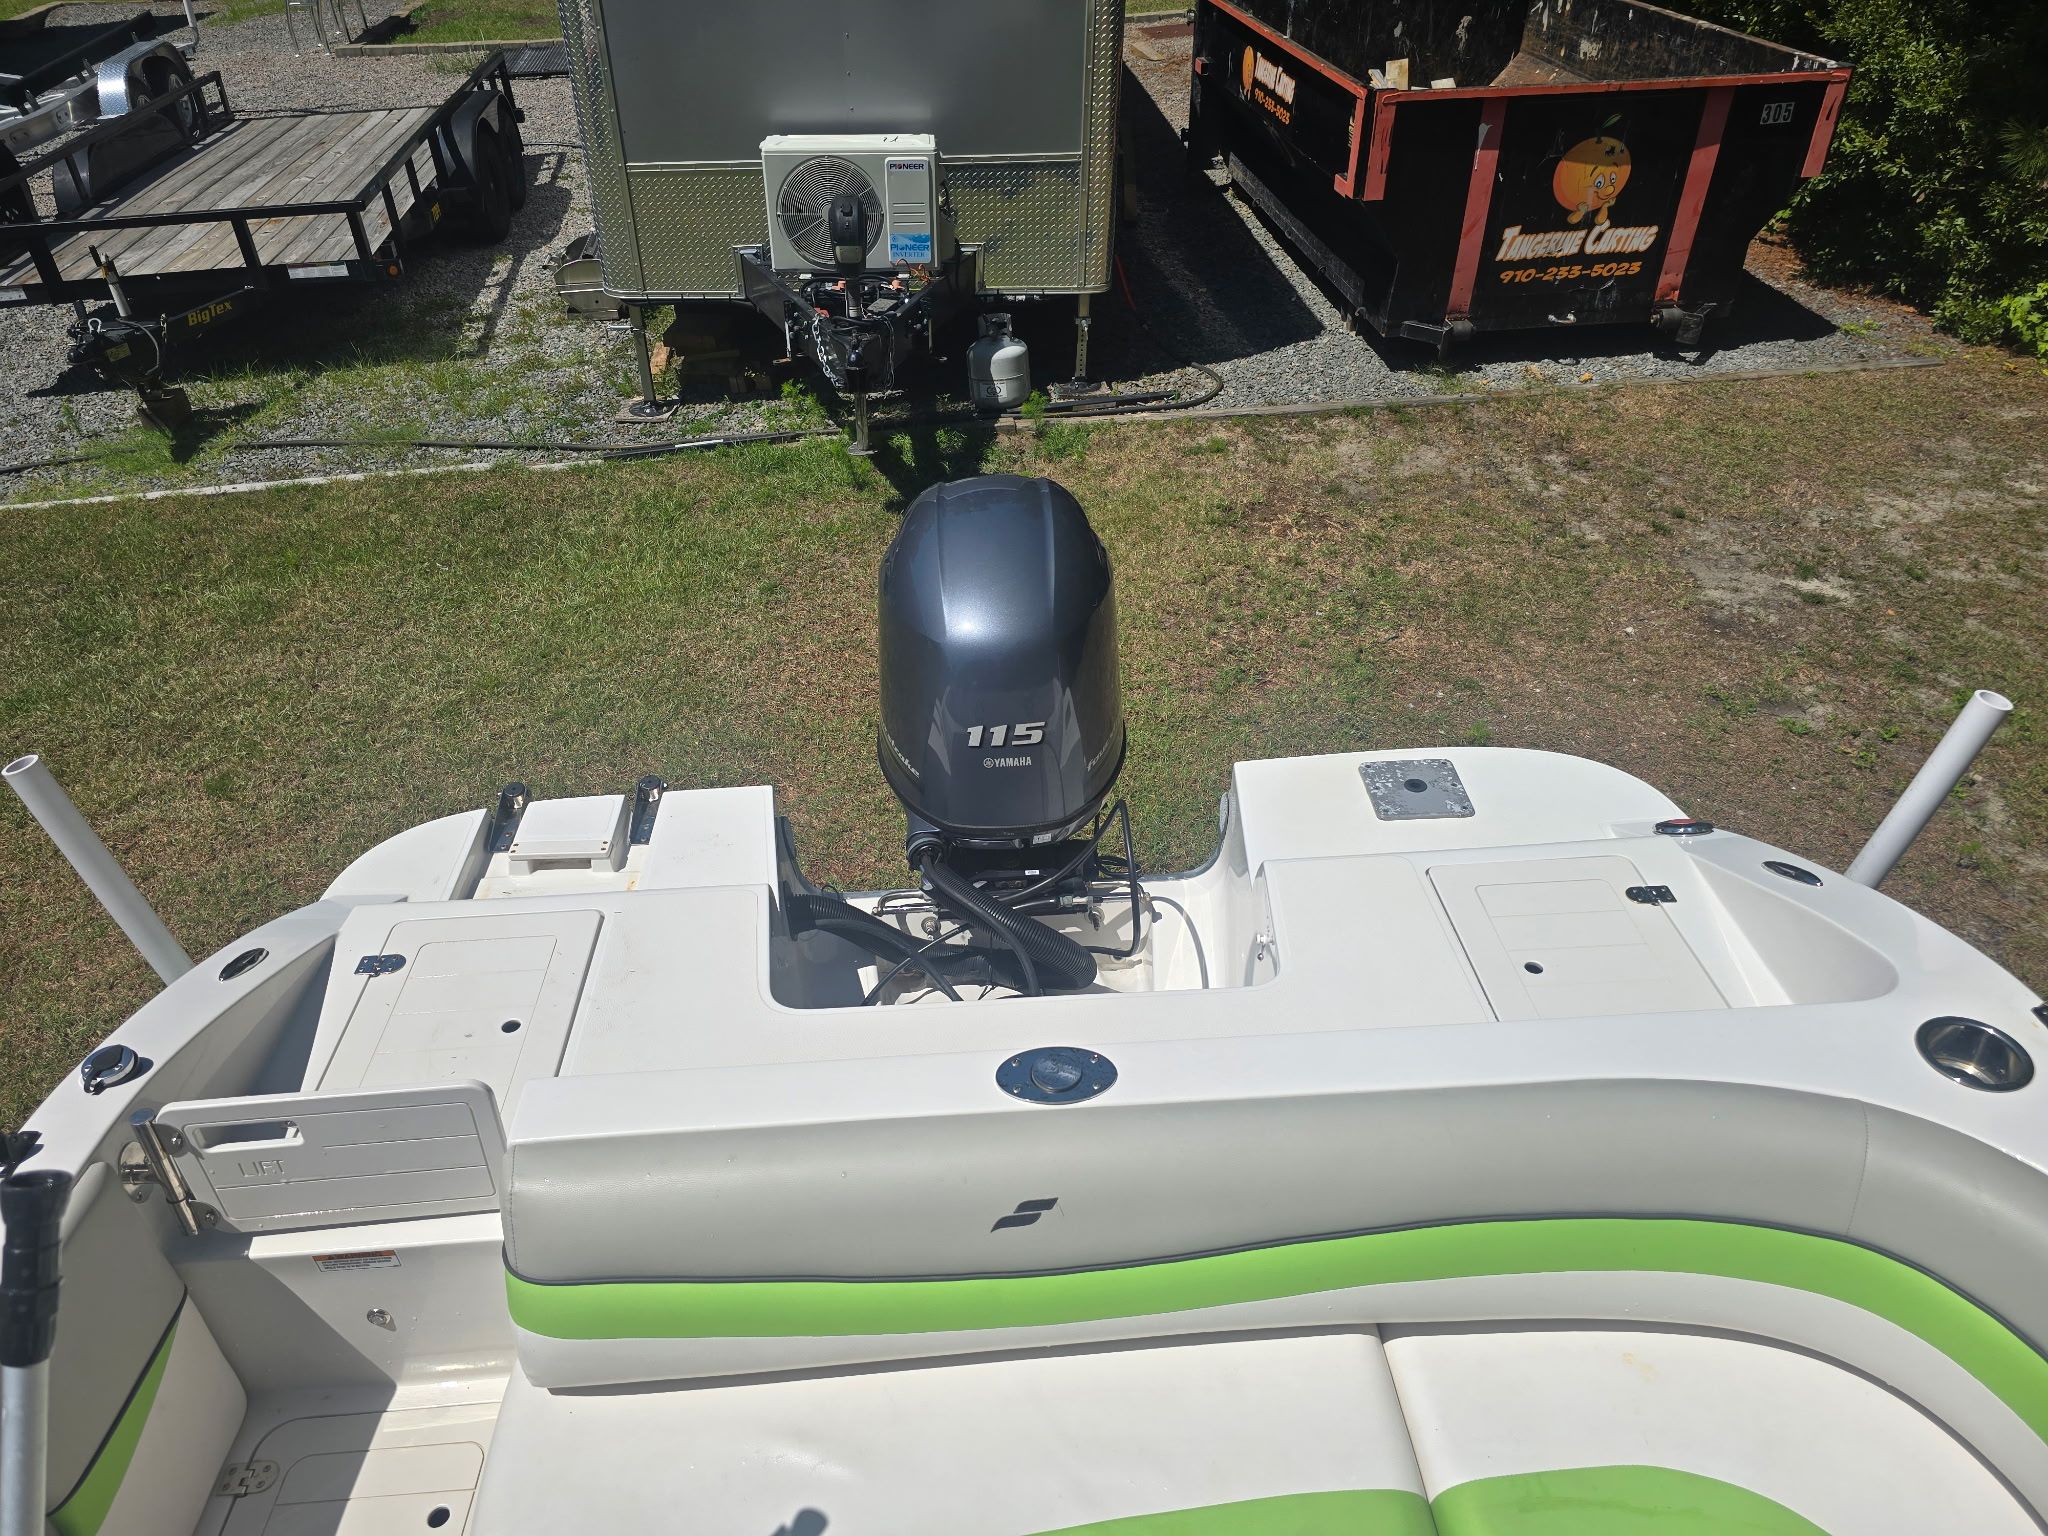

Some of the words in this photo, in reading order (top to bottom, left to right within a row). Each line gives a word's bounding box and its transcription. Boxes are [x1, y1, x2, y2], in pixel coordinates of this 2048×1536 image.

[1761, 103, 1794, 124] 305
[890, 243, 929, 251] PIONEER
[1584, 219, 1659, 255] CARTING
[1500, 261, 1642, 283] 910-233-5023
[966, 721, 1046, 747] 115
[995, 757, 1032, 768] YAMAHA
